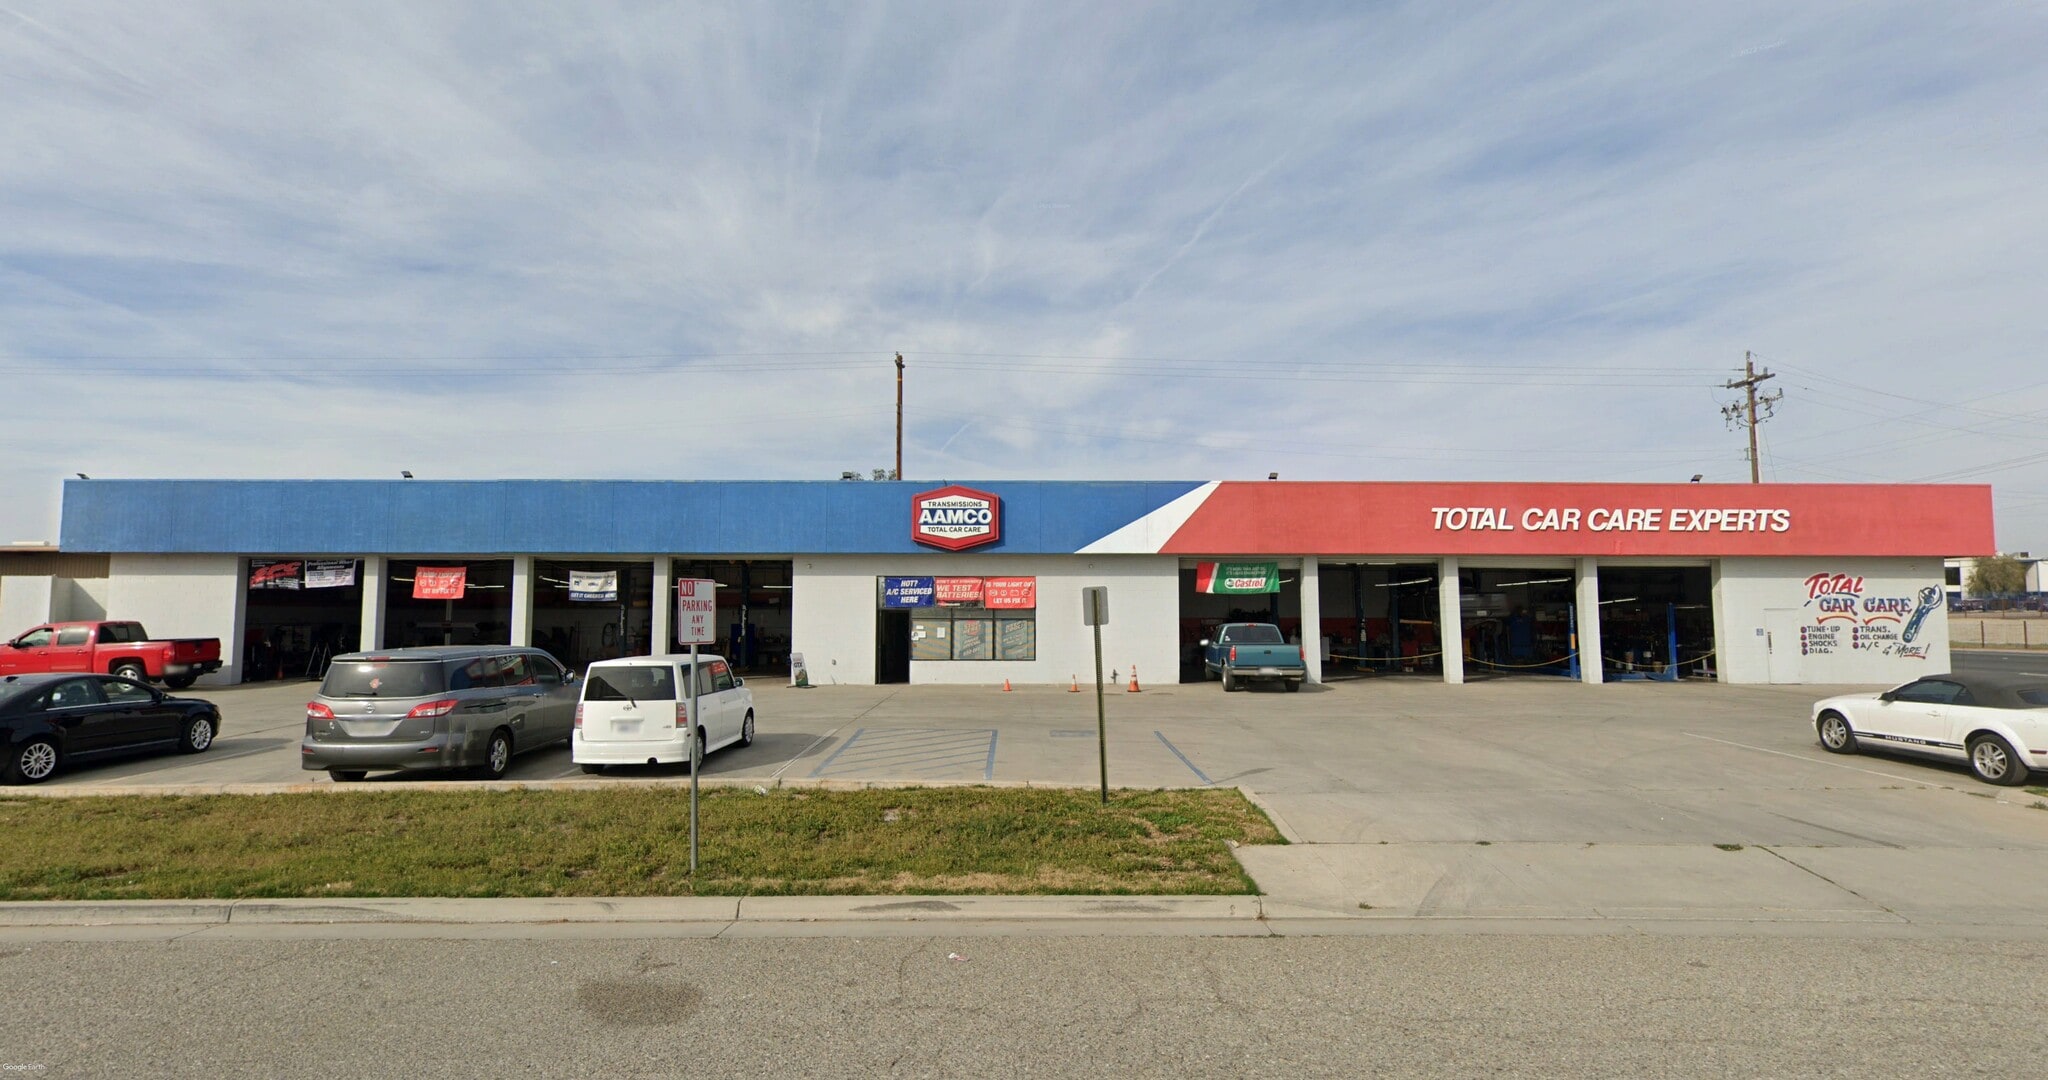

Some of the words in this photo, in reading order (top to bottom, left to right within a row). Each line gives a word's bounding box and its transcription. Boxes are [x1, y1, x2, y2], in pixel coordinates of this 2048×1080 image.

[918, 509, 992, 524] AAMCO
[1431, 507, 1514, 531] TOTAL
[1521, 507, 1581, 531] CAR
[1587, 508, 1663, 531] CARE
[1668, 508, 1790, 532] EXPERTS
[681, 581, 693, 595] NO
[1235, 579, 1263, 587] Castrol
[1804, 573, 1863, 599] TOTAL
[682, 600, 713, 611] PARKING
[1819, 597, 1858, 616] CAR
[1863, 597, 1912, 616] CARE
[691, 615, 704, 624] ANY
[691, 626, 704, 636] TIME
[1885, 735, 1926, 745] MUSTANG
